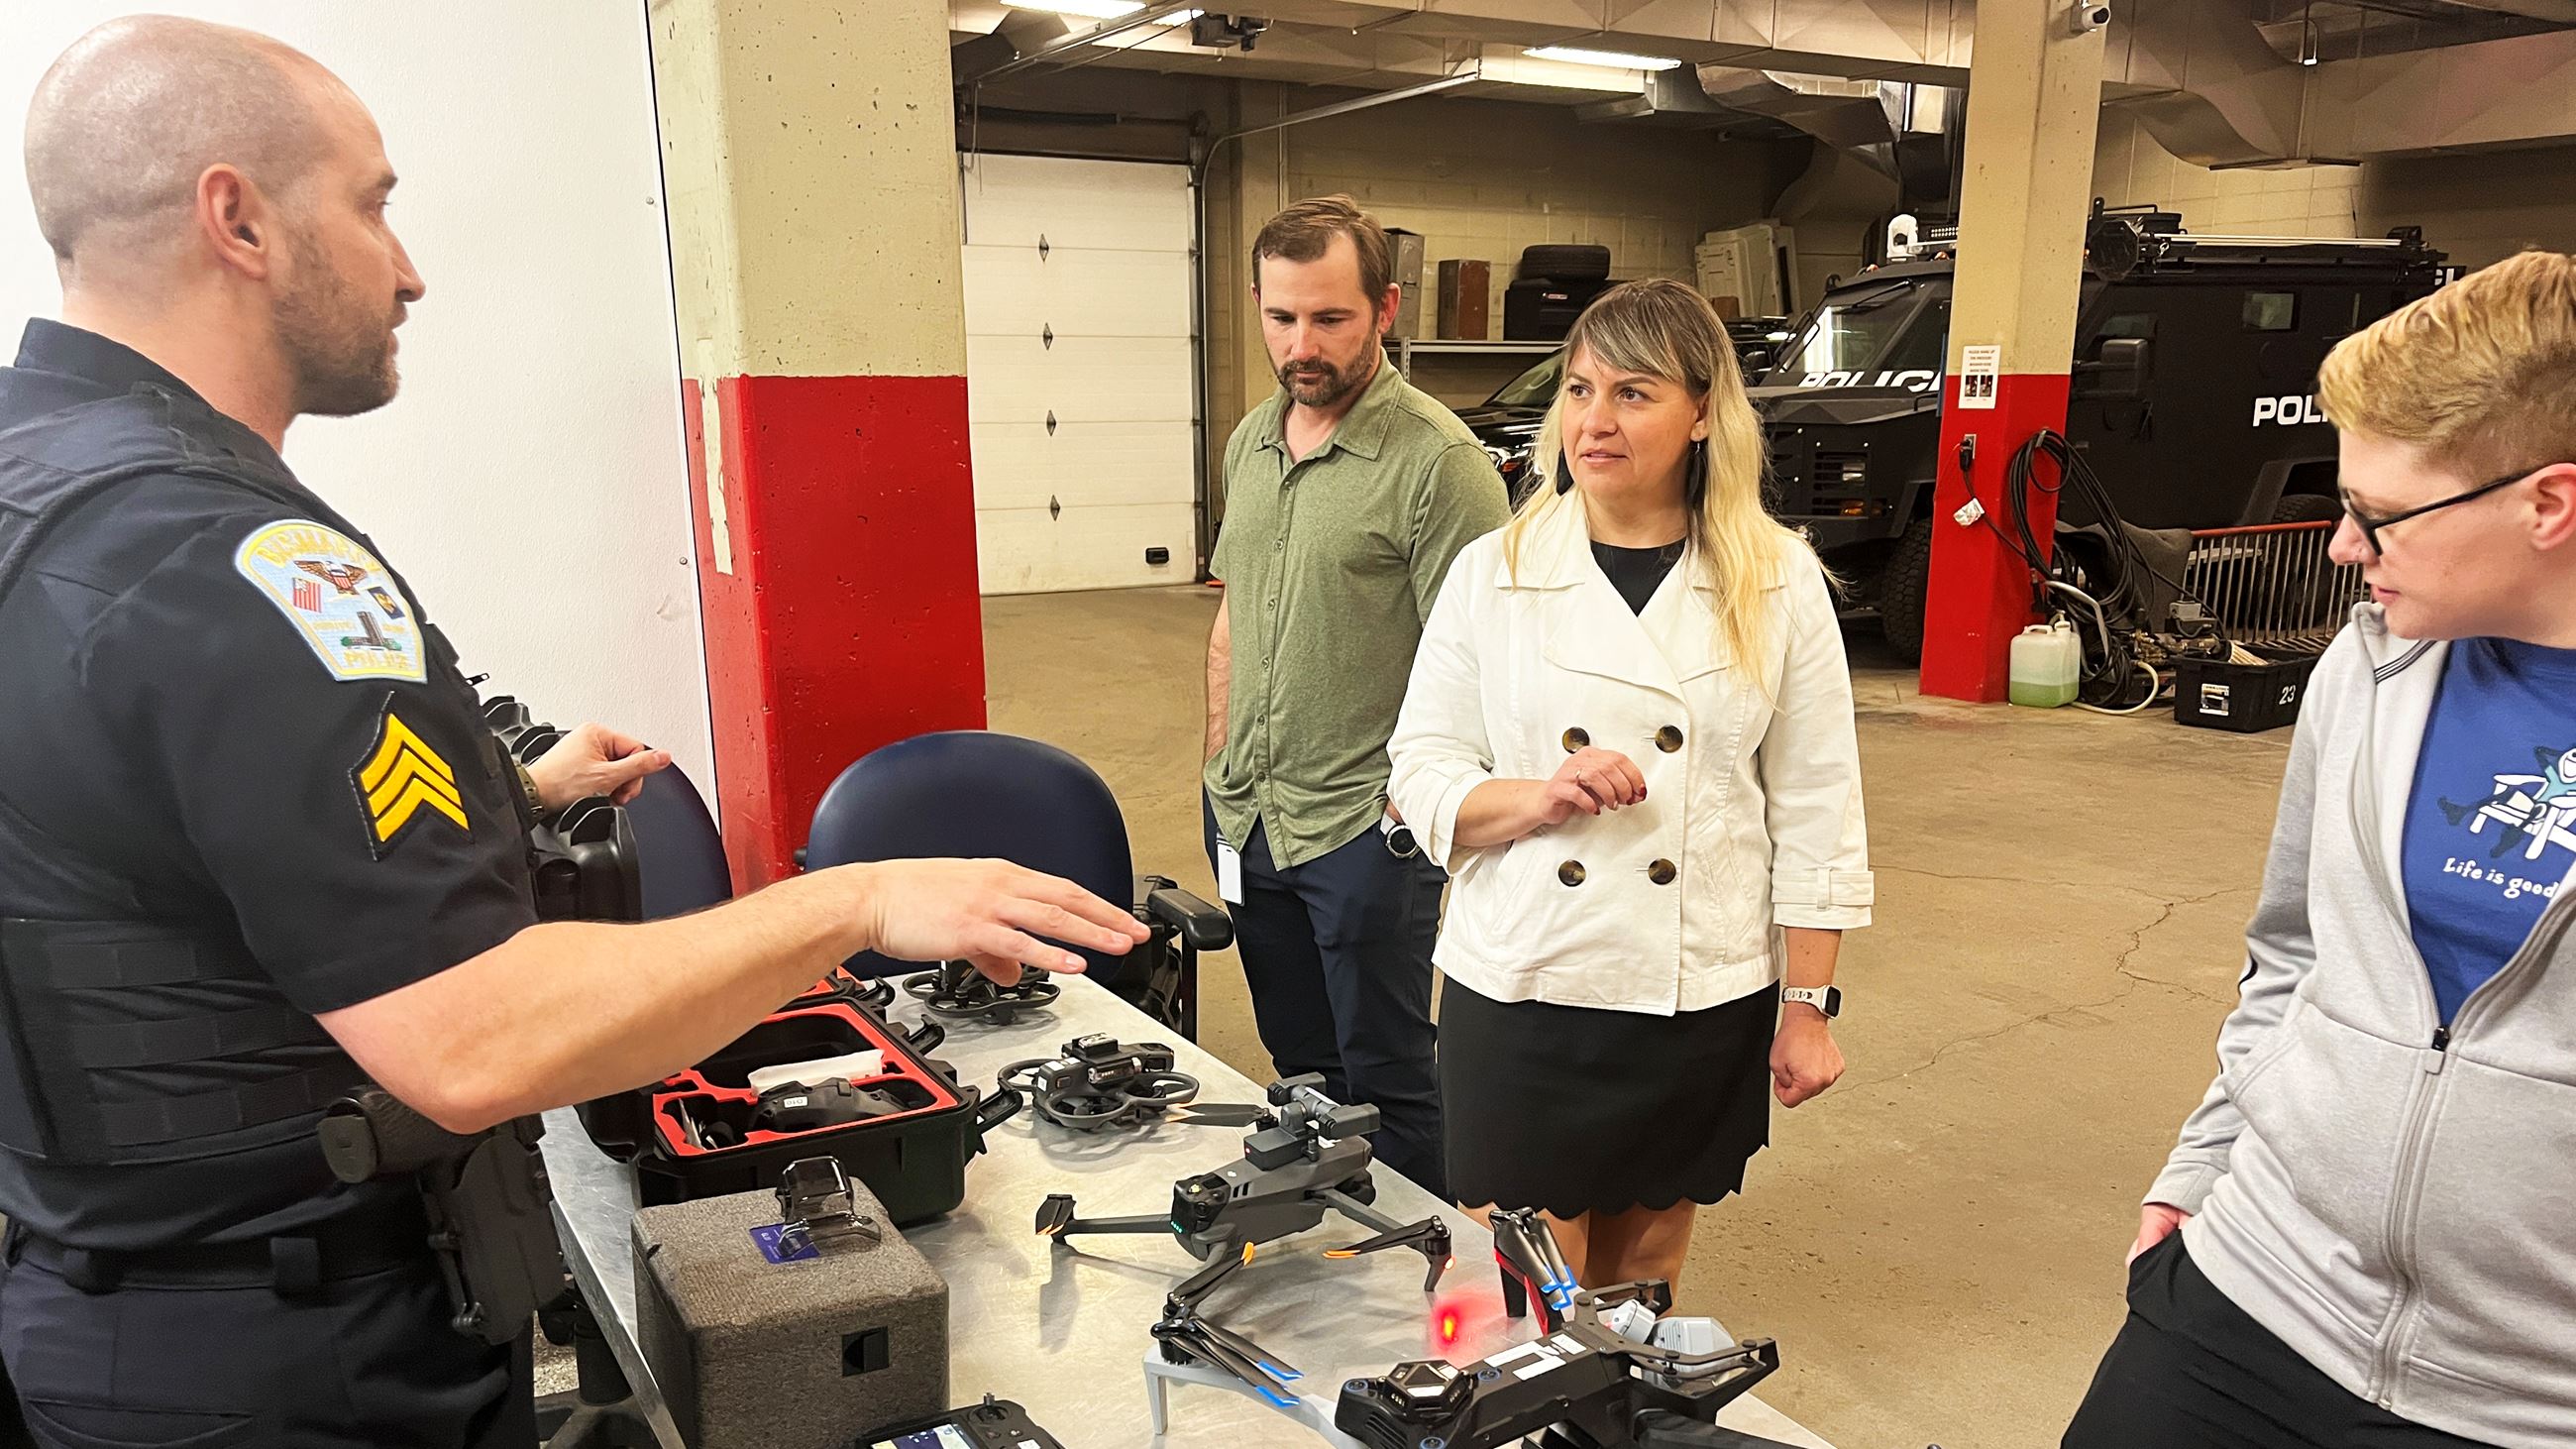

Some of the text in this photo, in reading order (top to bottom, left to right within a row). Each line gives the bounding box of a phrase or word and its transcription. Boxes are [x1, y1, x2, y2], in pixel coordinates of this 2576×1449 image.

[1798, 371, 1941, 392] POLIC
[2279, 685, 2296, 705] 23
[2443, 857, 2559, 899] Life is good
